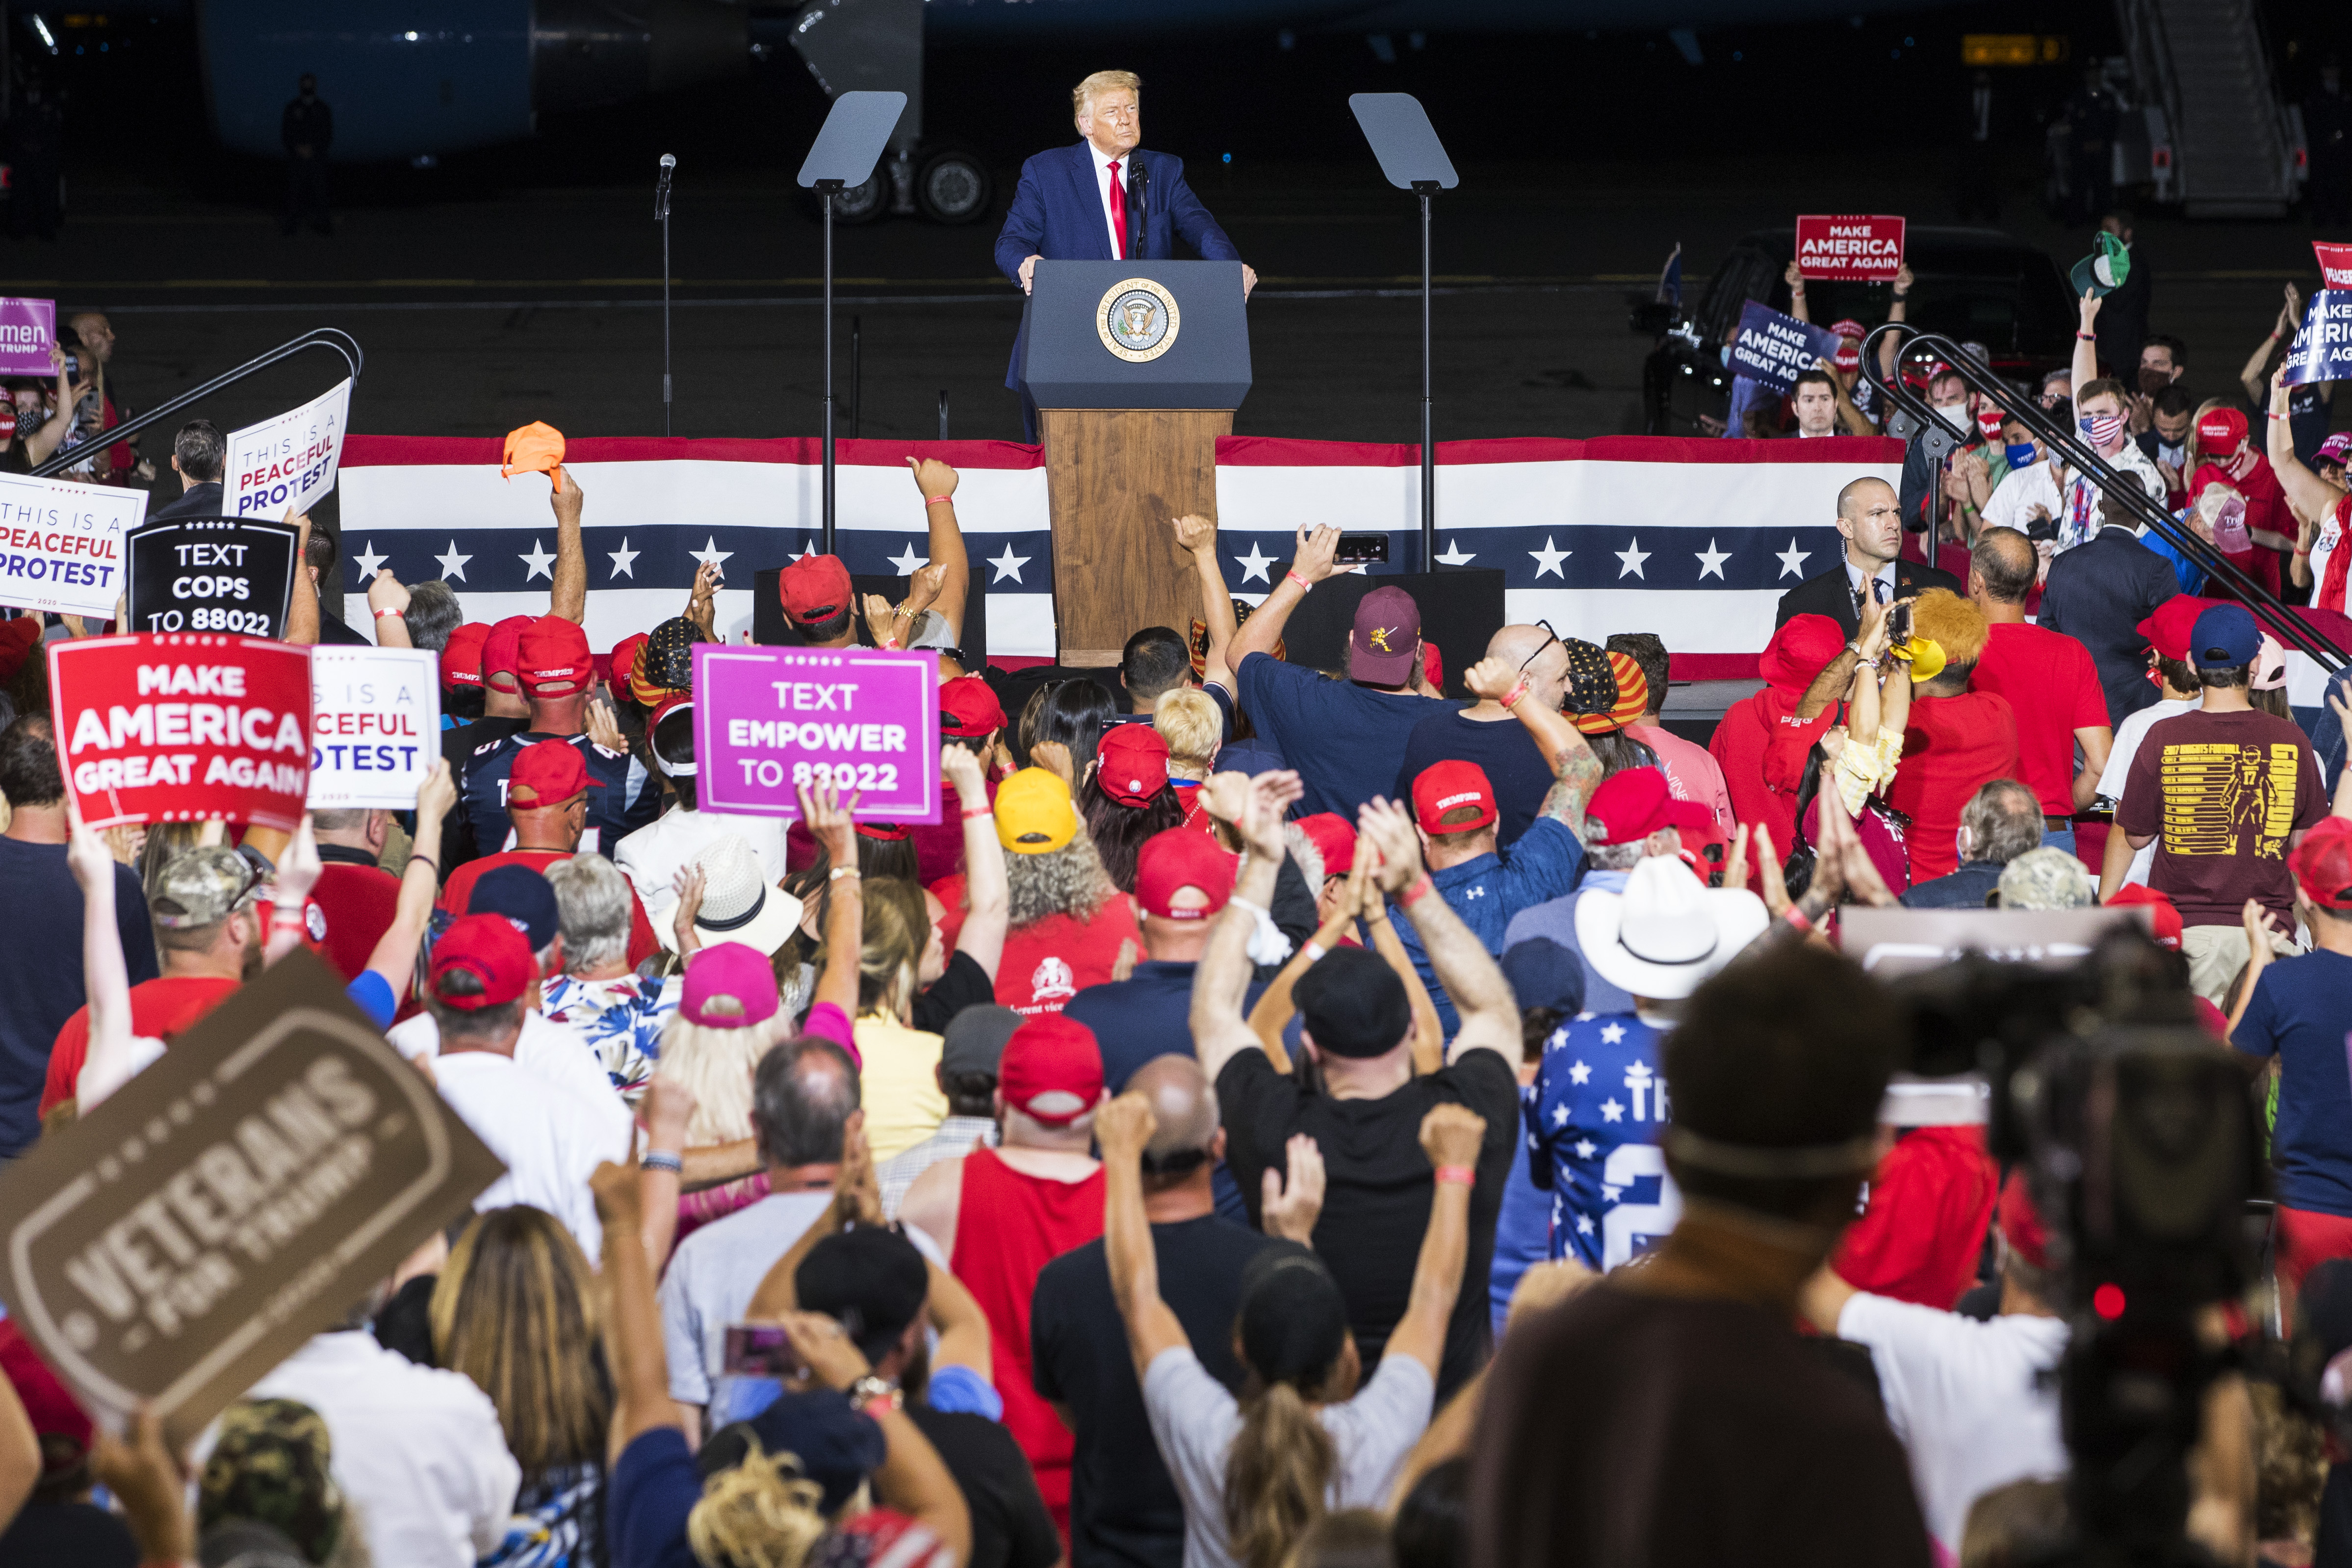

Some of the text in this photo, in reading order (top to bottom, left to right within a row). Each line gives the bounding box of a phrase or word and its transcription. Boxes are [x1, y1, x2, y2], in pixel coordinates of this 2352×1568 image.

[1830, 225, 1872, 238] MAKE
[1801, 239, 1898, 256] AMERICA
[1801, 257, 1898, 269] GREAT AGAIN
[1100, 282, 1139, 315] PRESIDENT
[1151, 285, 1161, 294] THE
[1162, 294, 1177, 328] UNITED
[2308, 304, 2352, 322] MAKE
[0, 344, 38, 354] TRUMP
[1108, 338, 1129, 357] SEAL
[1143, 335, 1172, 359] STATES
[1767, 321, 1807, 348] MAKE
[2291, 322, 2352, 349] AMERI
[1734, 346, 1778, 377] GREAT
[2286, 348, 2326, 370] GREAT
[243, 414, 335, 467] THIS IS A
[240, 435, 333, 491] PEACEFUL
[238, 455, 331, 517] PROTEST
[1, 503, 120, 534] THIS IS A
[0, 526, 117, 560] PEACEFUL
[174, 543, 249, 567] TEXT
[172, 575, 250, 600] COPS
[148, 607, 270, 637] TO 88022
[137, 664, 247, 697] MAKE
[346, 684, 374, 704] IS
[396, 685, 414, 705] A
[771, 681, 860, 711] TEXT
[70, 703, 306, 757] AMERICA
[728, 718, 907, 752] EMPOWER
[74, 753, 306, 797] GREAT AGAIN
[737, 758, 784, 788] TO
[2243, 771, 2257, 785] 17
[66, 1054, 377, 1320] VETERANS
[146, 1252, 238, 1336] FOR
[231, 1133, 373, 1261] TRUMP
